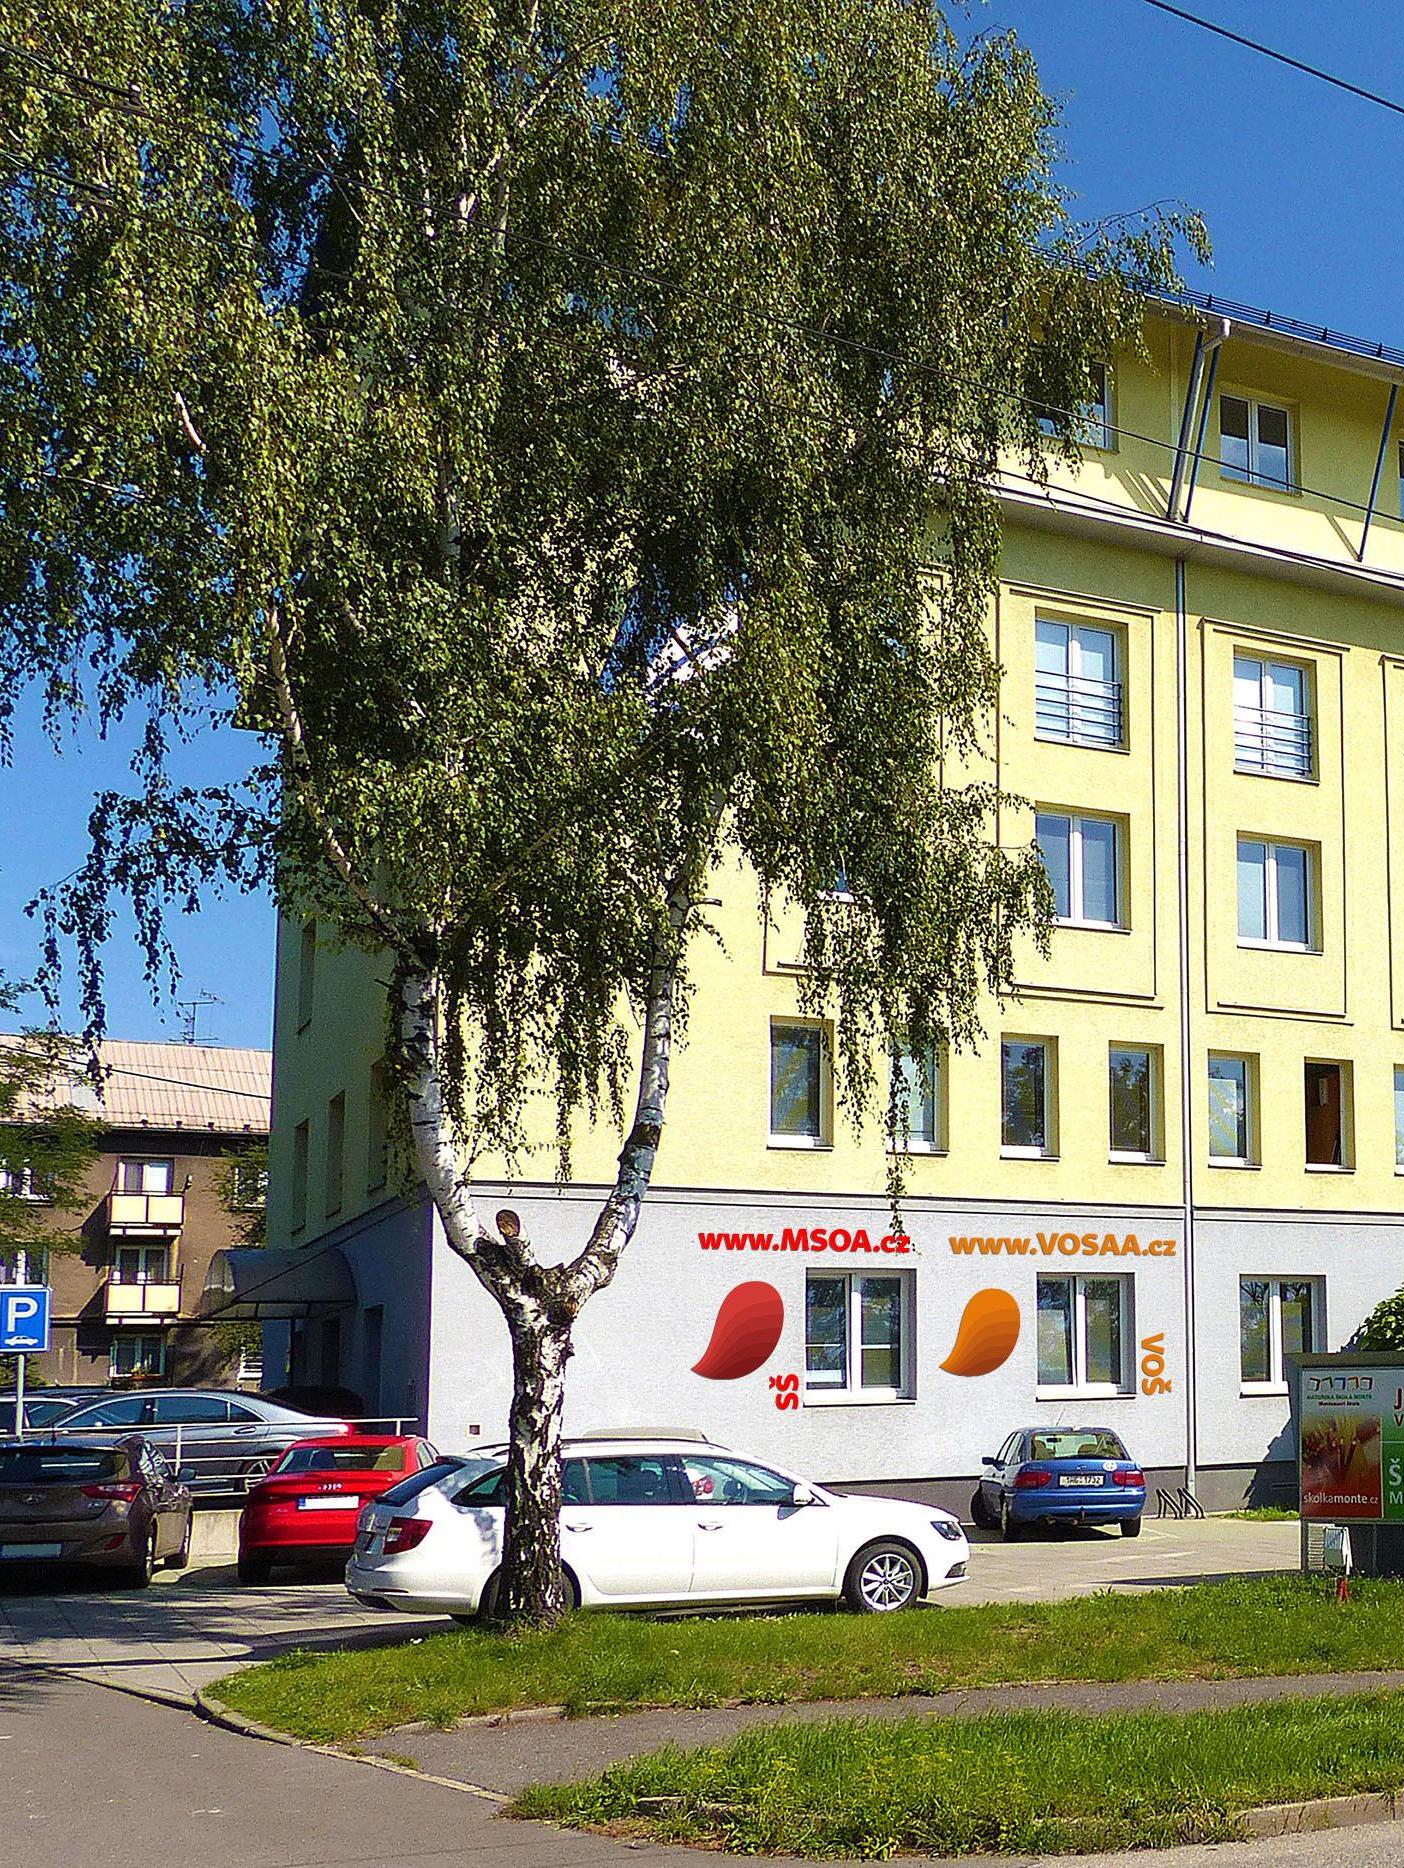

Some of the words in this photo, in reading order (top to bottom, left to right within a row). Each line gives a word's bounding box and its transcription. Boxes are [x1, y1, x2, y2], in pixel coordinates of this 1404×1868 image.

[698, 1228, 911, 1254] www.MSOA.cz
[949, 1232, 1176, 1256] www.VOSAA.cz
[7, 1297, 38, 1332] P
[1141, 1333, 1172, 1396] VOŠ
[768, 1373, 799, 1410] SŠ
[1394, 1413, 1404, 1427] V
